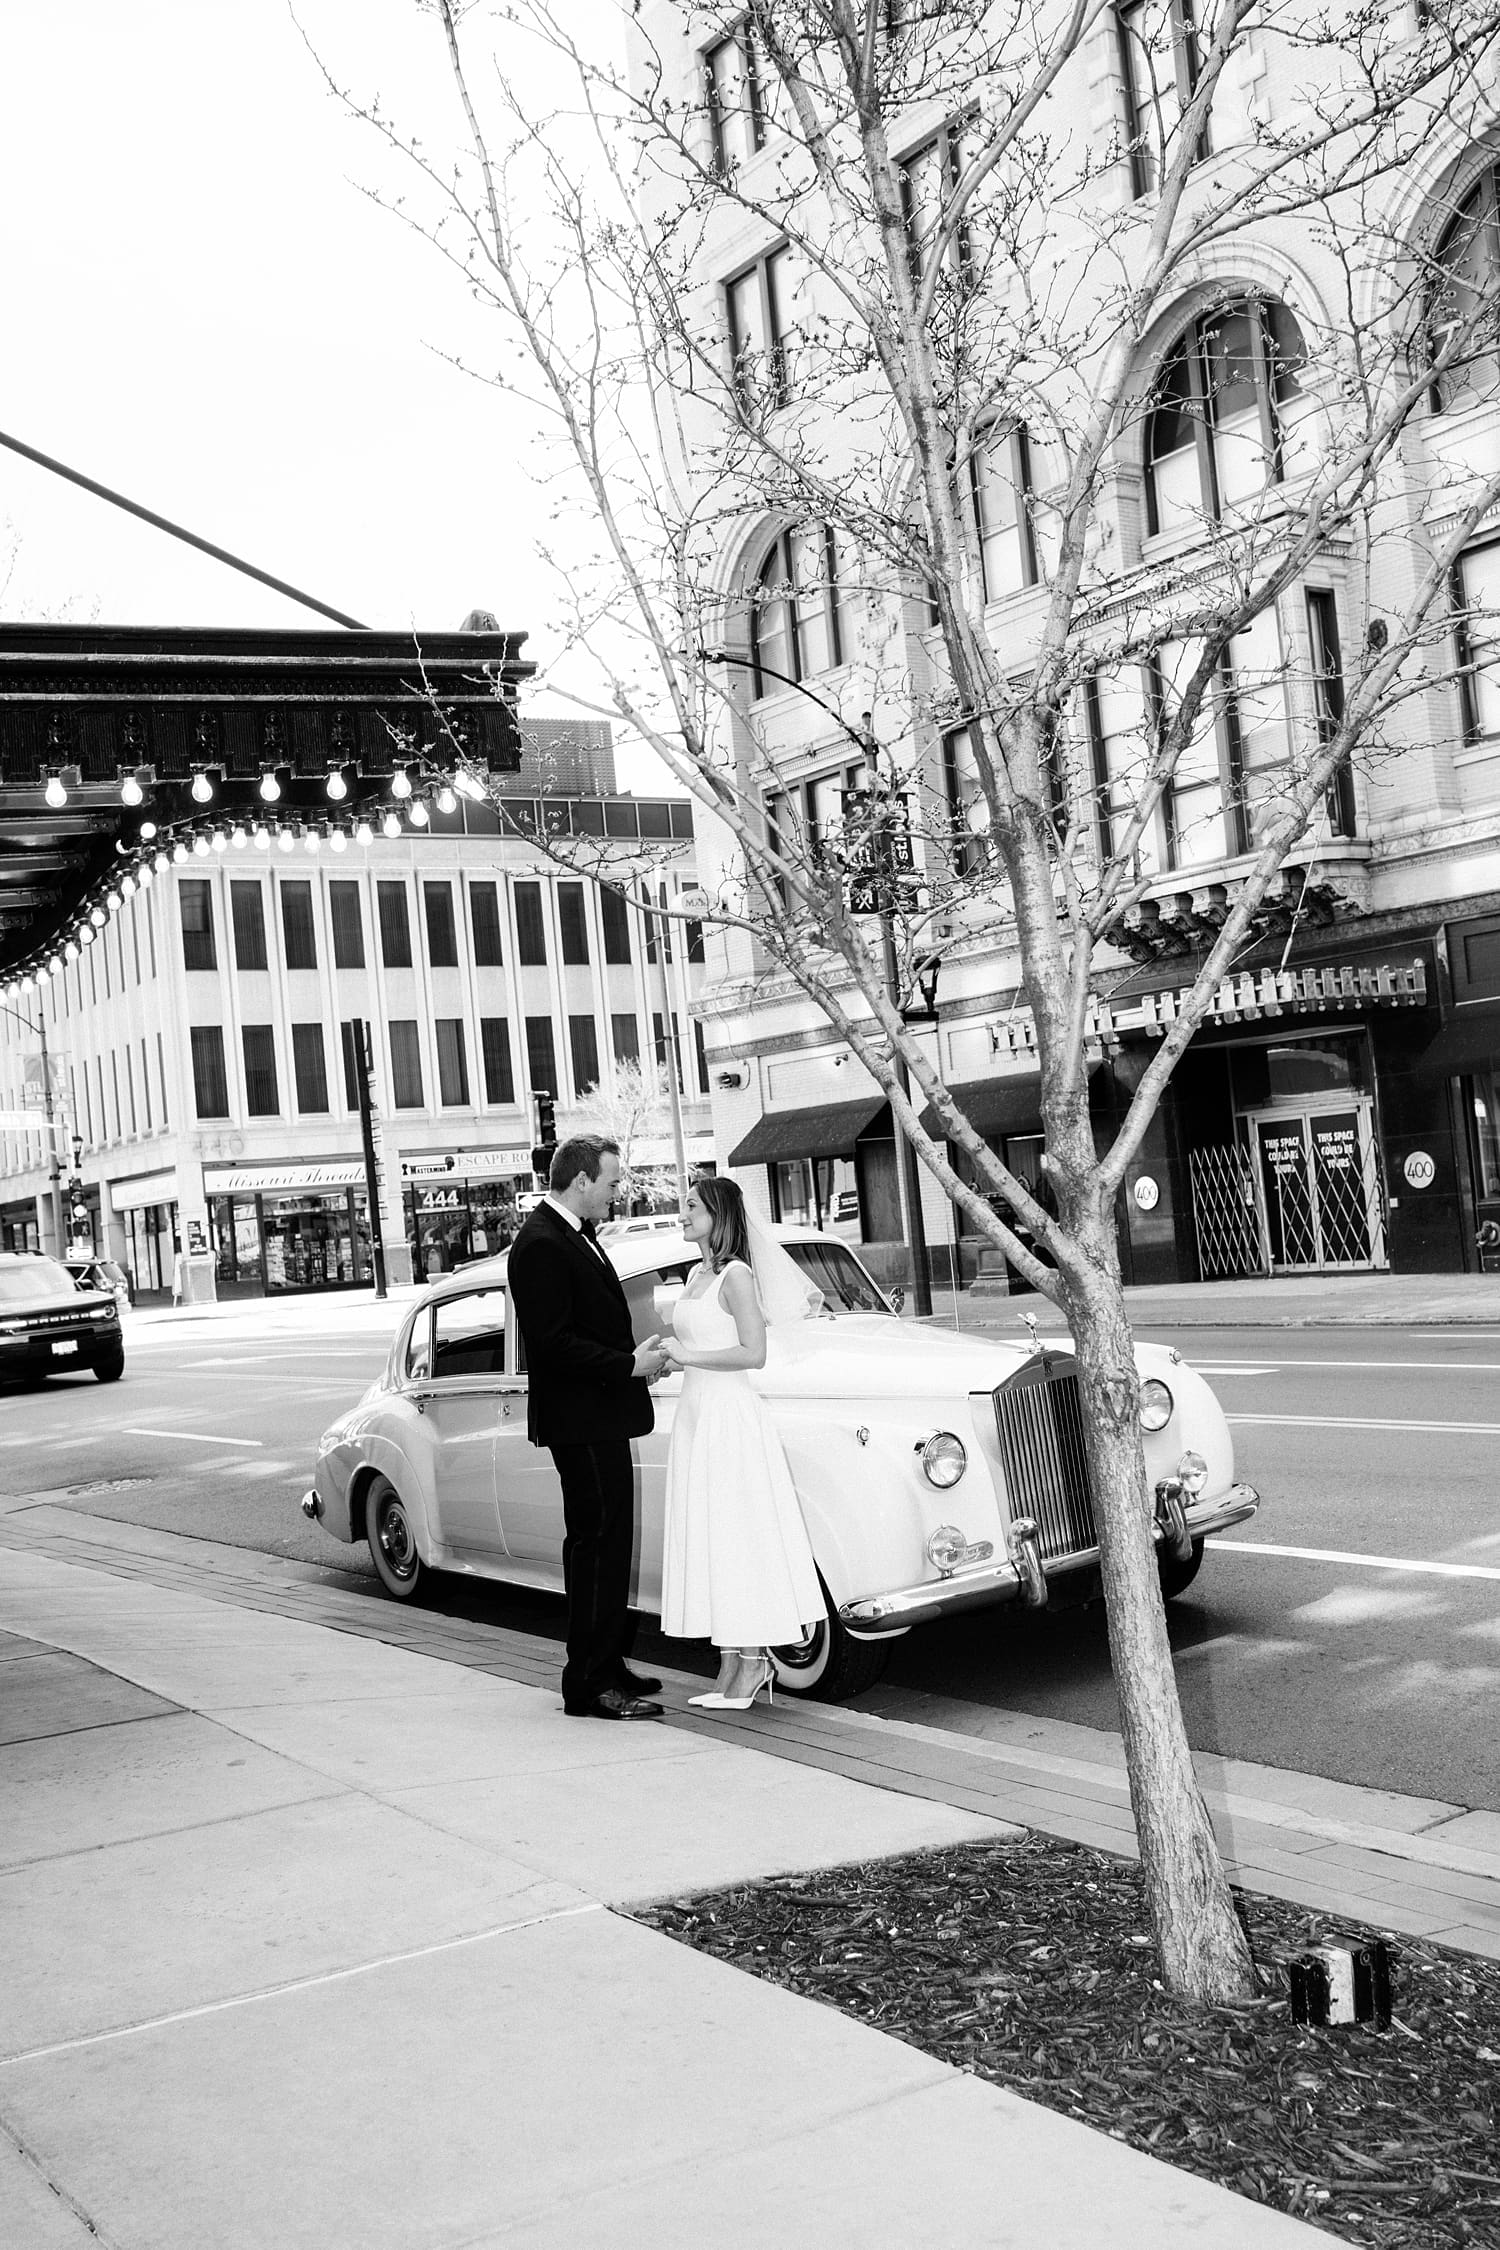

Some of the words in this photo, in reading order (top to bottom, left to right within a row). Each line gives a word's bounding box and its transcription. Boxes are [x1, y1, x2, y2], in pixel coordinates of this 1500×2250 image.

[1264, 1139, 1279, 1149] THIS
[1280, 1136, 1299, 1148] SPACE
[1317, 1132, 1332, 1143] THIS
[1333, 1130, 1354, 1141] SPACE
[1321, 1145, 1343, 1156] COULD
[458, 1153, 508, 1167] ESCAPE
[1407, 1161, 1433, 1179] 400
[217, 1171, 295, 1189] Missouri
[299, 1167, 367, 1184] Threads
[423, 1190, 459, 1208] 444
[1136, 1185, 1157, 1200] 400
